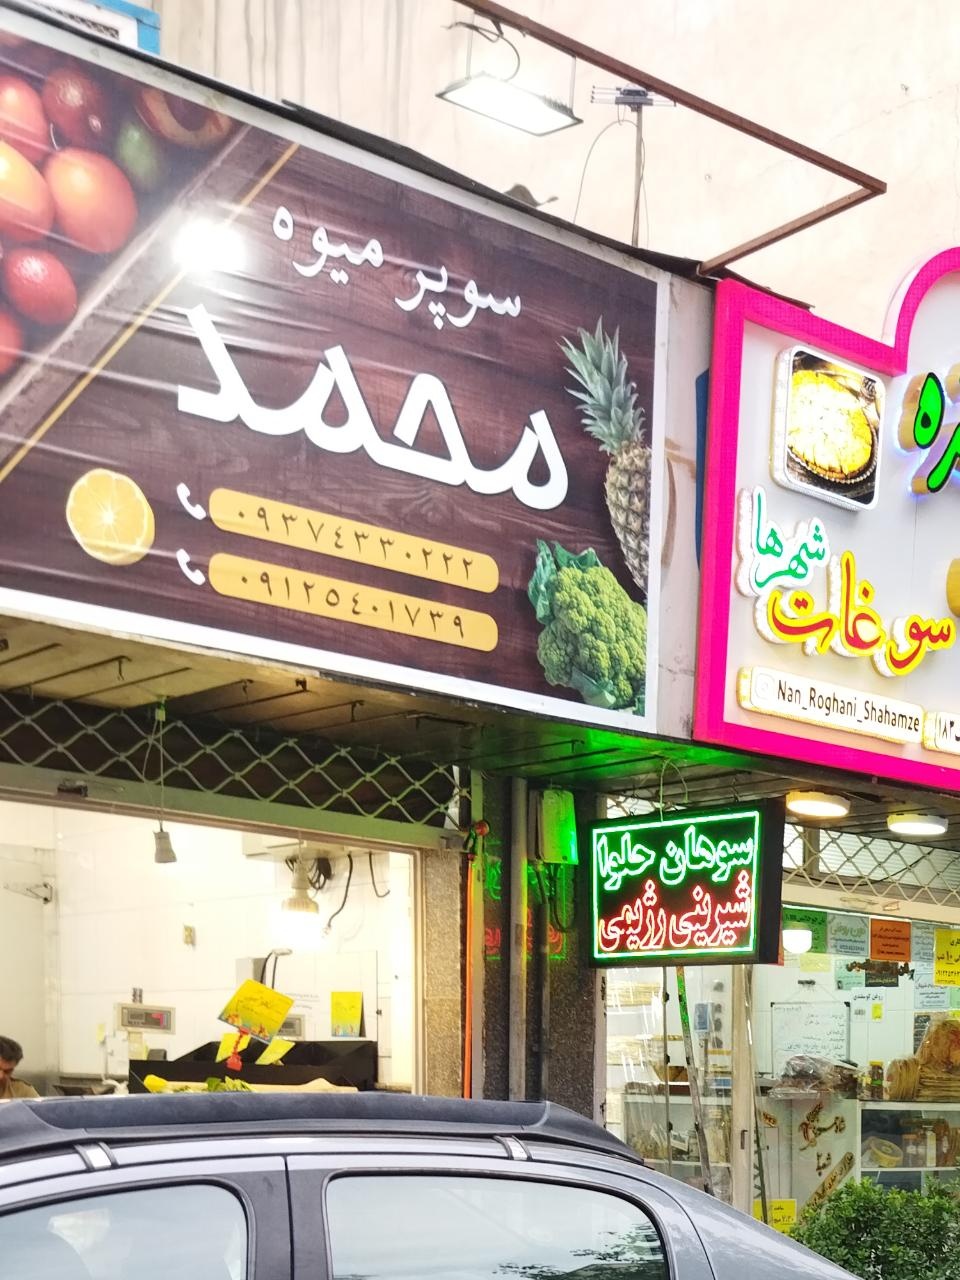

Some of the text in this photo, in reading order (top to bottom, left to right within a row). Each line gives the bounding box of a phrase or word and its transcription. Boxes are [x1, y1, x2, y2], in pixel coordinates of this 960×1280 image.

[272, 206, 522, 330] سوپر میوه
[177, 303, 569, 511] محمد
[753, 494, 955, 676] سوغات شهرها
[777, 679, 920, 733] Nan_Roghani_Shahamze
[596, 824, 756, 891] سوهان حلوا
[598, 879, 668, 951] رژیمی
[668, 869, 754, 948] شیرینی
